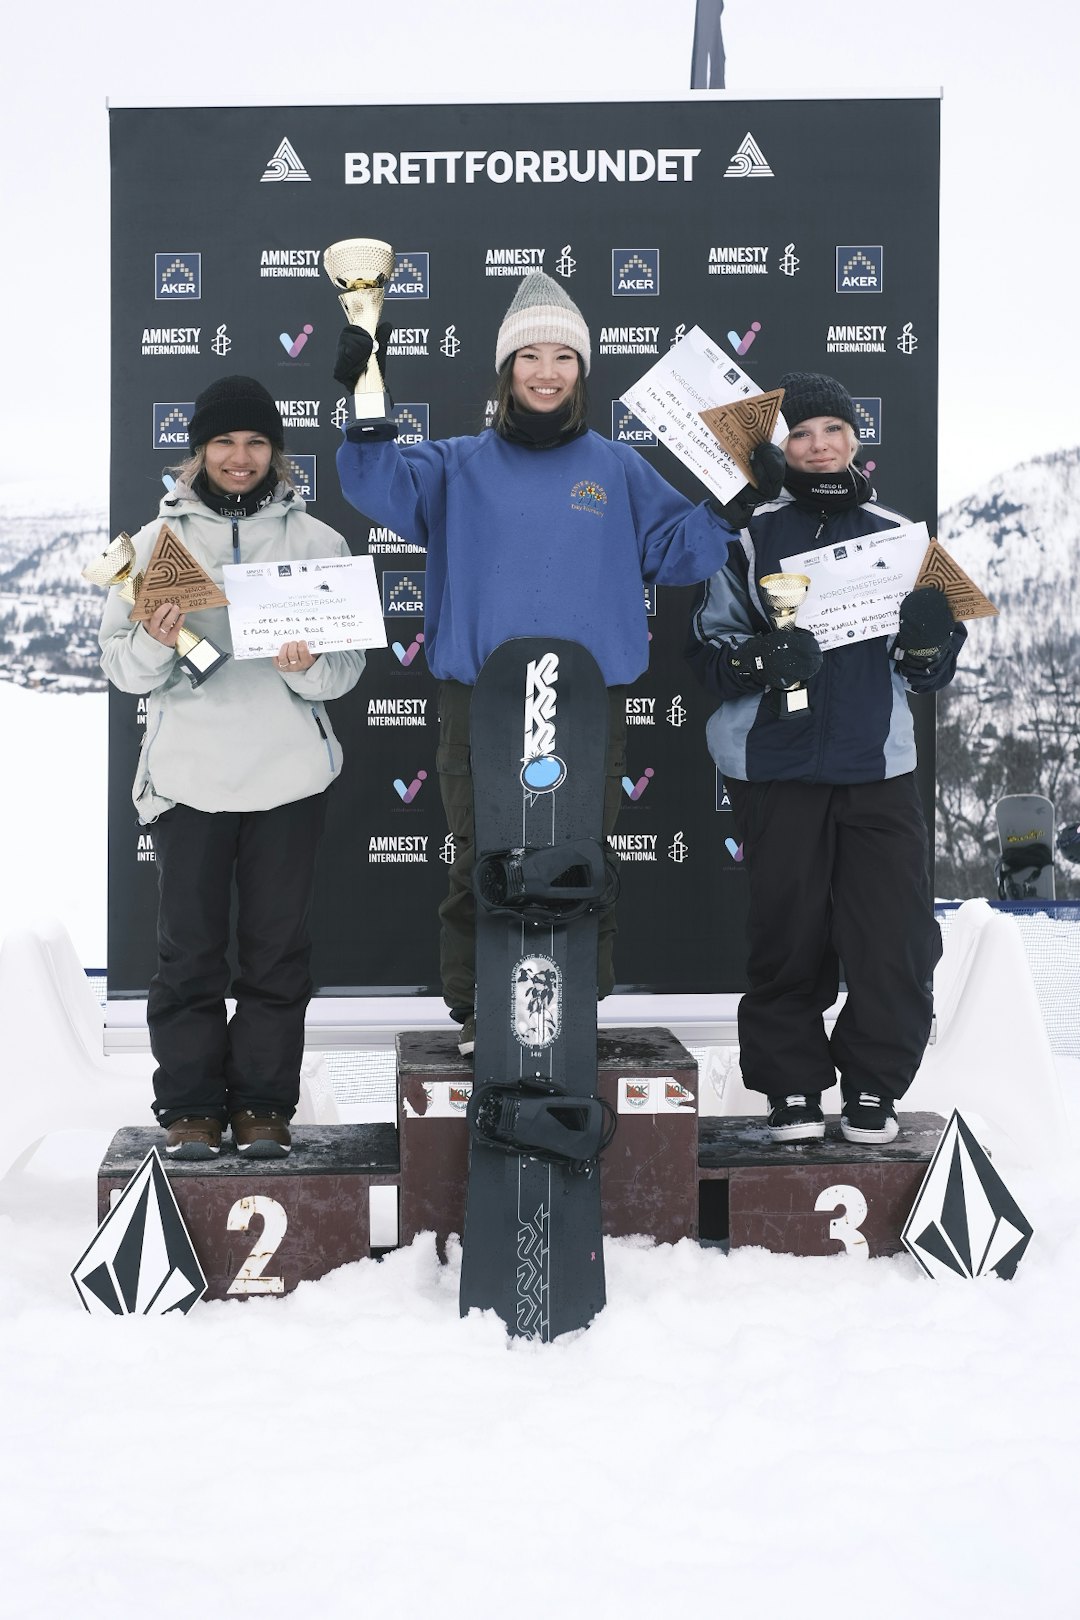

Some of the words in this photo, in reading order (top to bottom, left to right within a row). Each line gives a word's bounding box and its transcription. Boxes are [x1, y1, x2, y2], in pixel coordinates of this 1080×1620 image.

[345, 149, 702, 185] BRETTFORBUNDET
[261, 250, 321, 266] AMNESTY
[486, 248, 546, 265] AMNESTY
[709, 247, 769, 263] AMNESTY
[261, 267, 320, 278] INTERNATIONAL
[709, 264, 768, 275] INTERNATIONAL
[618, 279, 654, 290] AKER
[842, 276, 878, 287] AKER
[161, 283, 196, 294] AKER
[389, 283, 424, 294] AKER
[142, 328, 201, 344] AMNESTY
[389, 328, 430, 344] NESTY
[600, 327, 660, 343] AMNESTY
[827, 325, 887, 341] AMNESTY
[142, 345, 201, 356] INTERNATIONAL
[386, 345, 430, 356] RNATIONAL
[600, 345, 660, 355] INTERNATIONAL
[827, 342, 887, 353] INTERNATIONAL
[665, 390, 682, 406] OPEN
[275, 401, 321, 416] NESTY
[282, 417, 320, 427] NATIONAL
[394, 435, 424, 445] KER
[617, 431, 653, 441] AKER
[811, 487, 849, 495] SNOWBOARD
[189, 598, 208, 607] 2023
[388, 601, 424, 611] AKER
[956, 608, 975, 617] 2023
[367, 699, 428, 715] AMNESTY
[625, 698, 656, 714] ESTY
[367, 716, 427, 726] INTERNATIONAL
[368, 836, 428, 851] AMNESTY
[606, 835, 658, 850] MNESTY
[368, 853, 428, 863] INTERNATIONAL
[616, 851, 658, 861] NATIONAL
[814, 1184, 870, 1260] 3
[226, 1195, 288, 1295] 2
